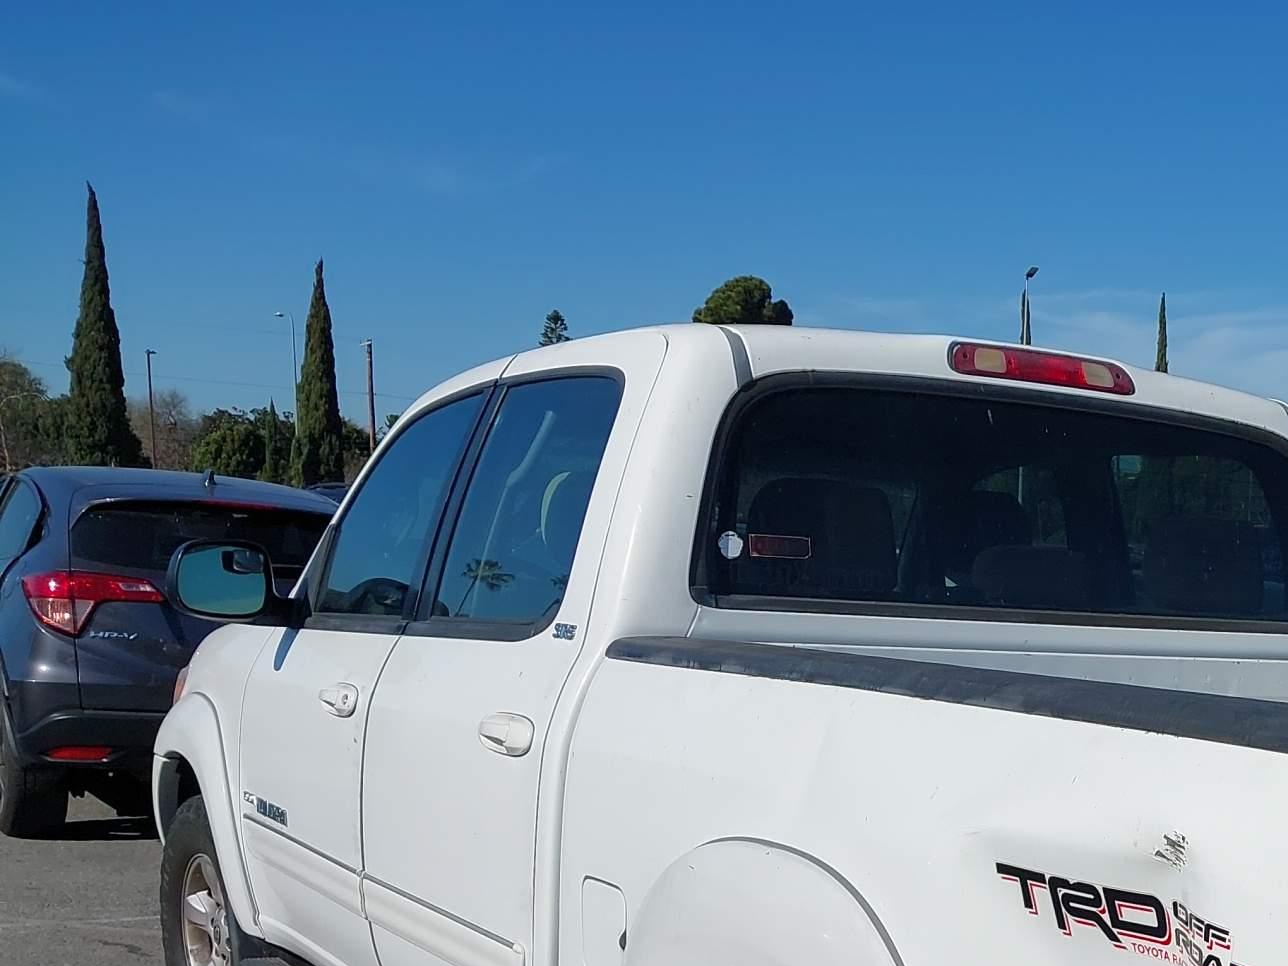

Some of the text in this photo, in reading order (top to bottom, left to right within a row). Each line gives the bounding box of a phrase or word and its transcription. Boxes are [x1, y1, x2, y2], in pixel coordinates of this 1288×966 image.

[995, 861, 1171, 950] TRD
[1172, 900, 1231, 950] OFF
[1131, 942, 1170, 962] TOYOTA
